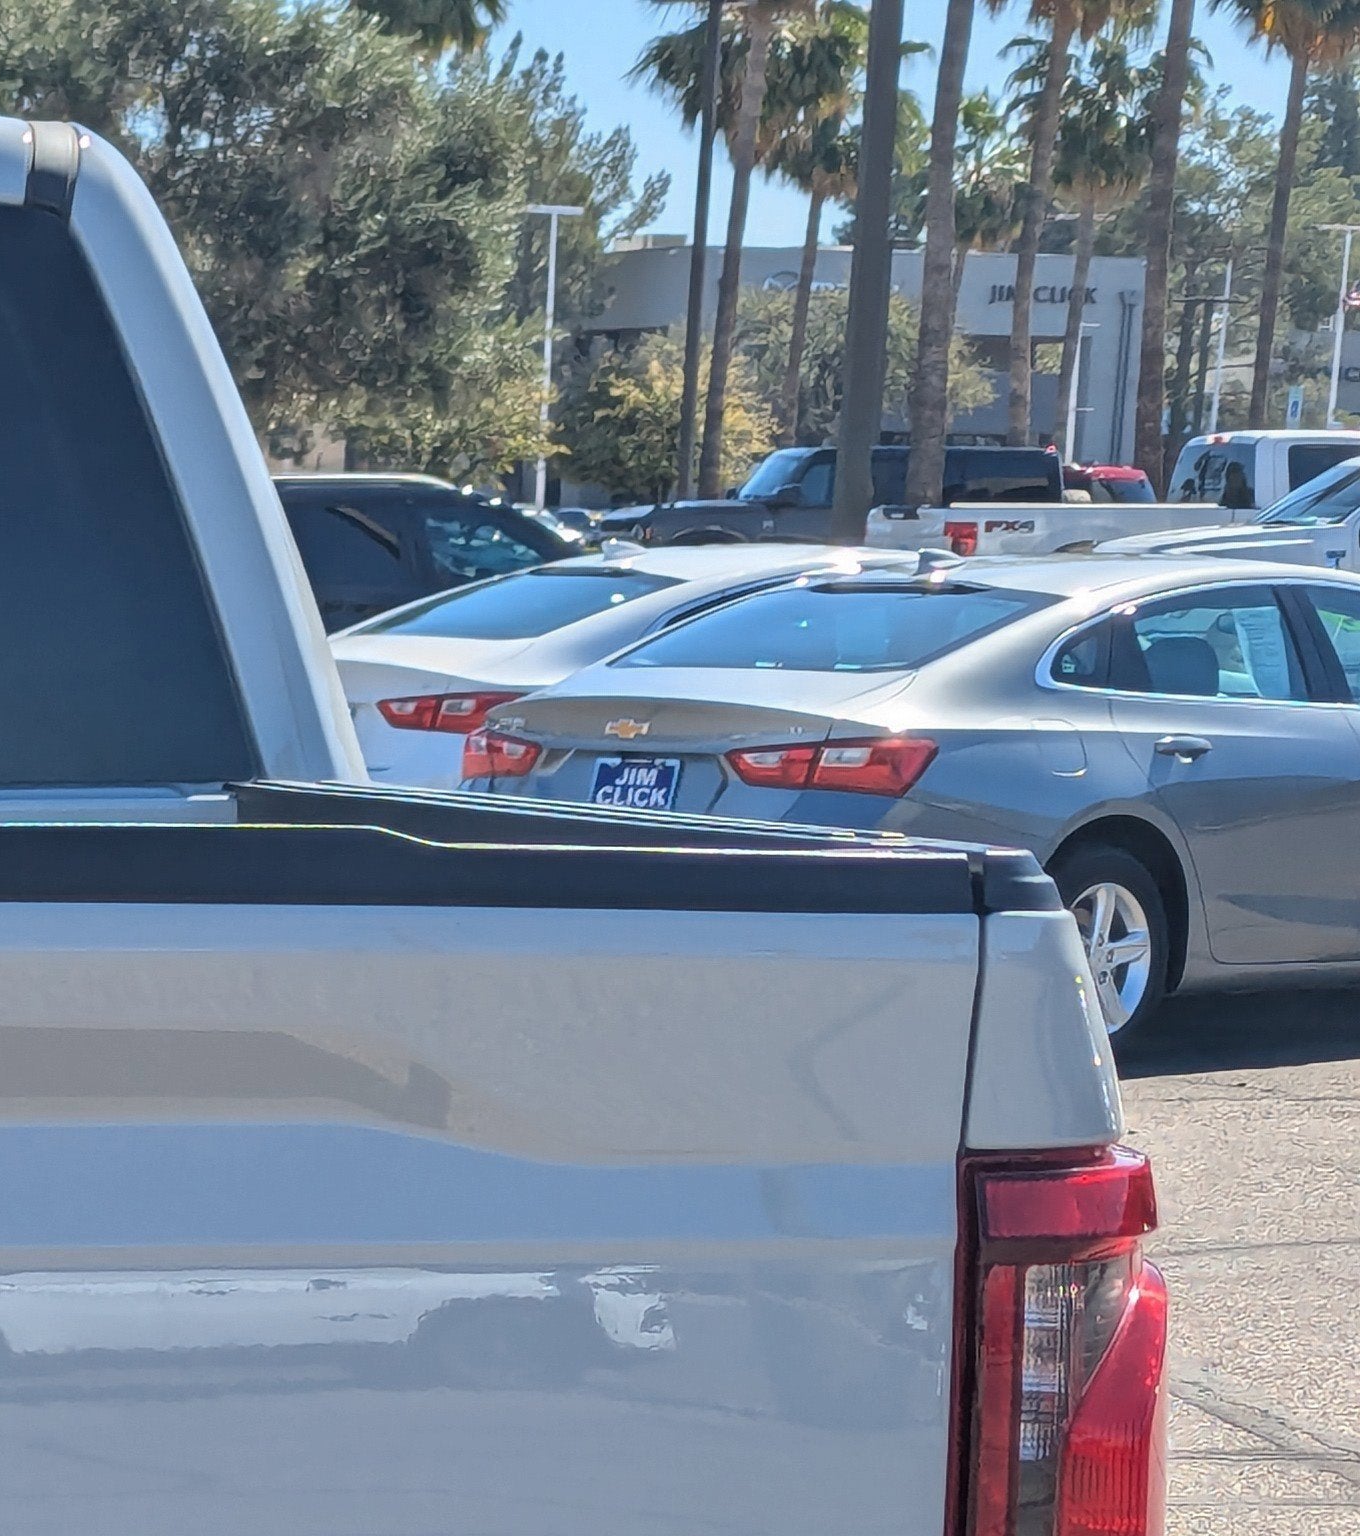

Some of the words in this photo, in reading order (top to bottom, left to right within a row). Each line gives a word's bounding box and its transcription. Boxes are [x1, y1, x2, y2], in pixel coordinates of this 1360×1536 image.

[984, 520, 1035, 534] FX4
[614, 767, 659, 786] JIM
[595, 785, 668, 807] CLICK
